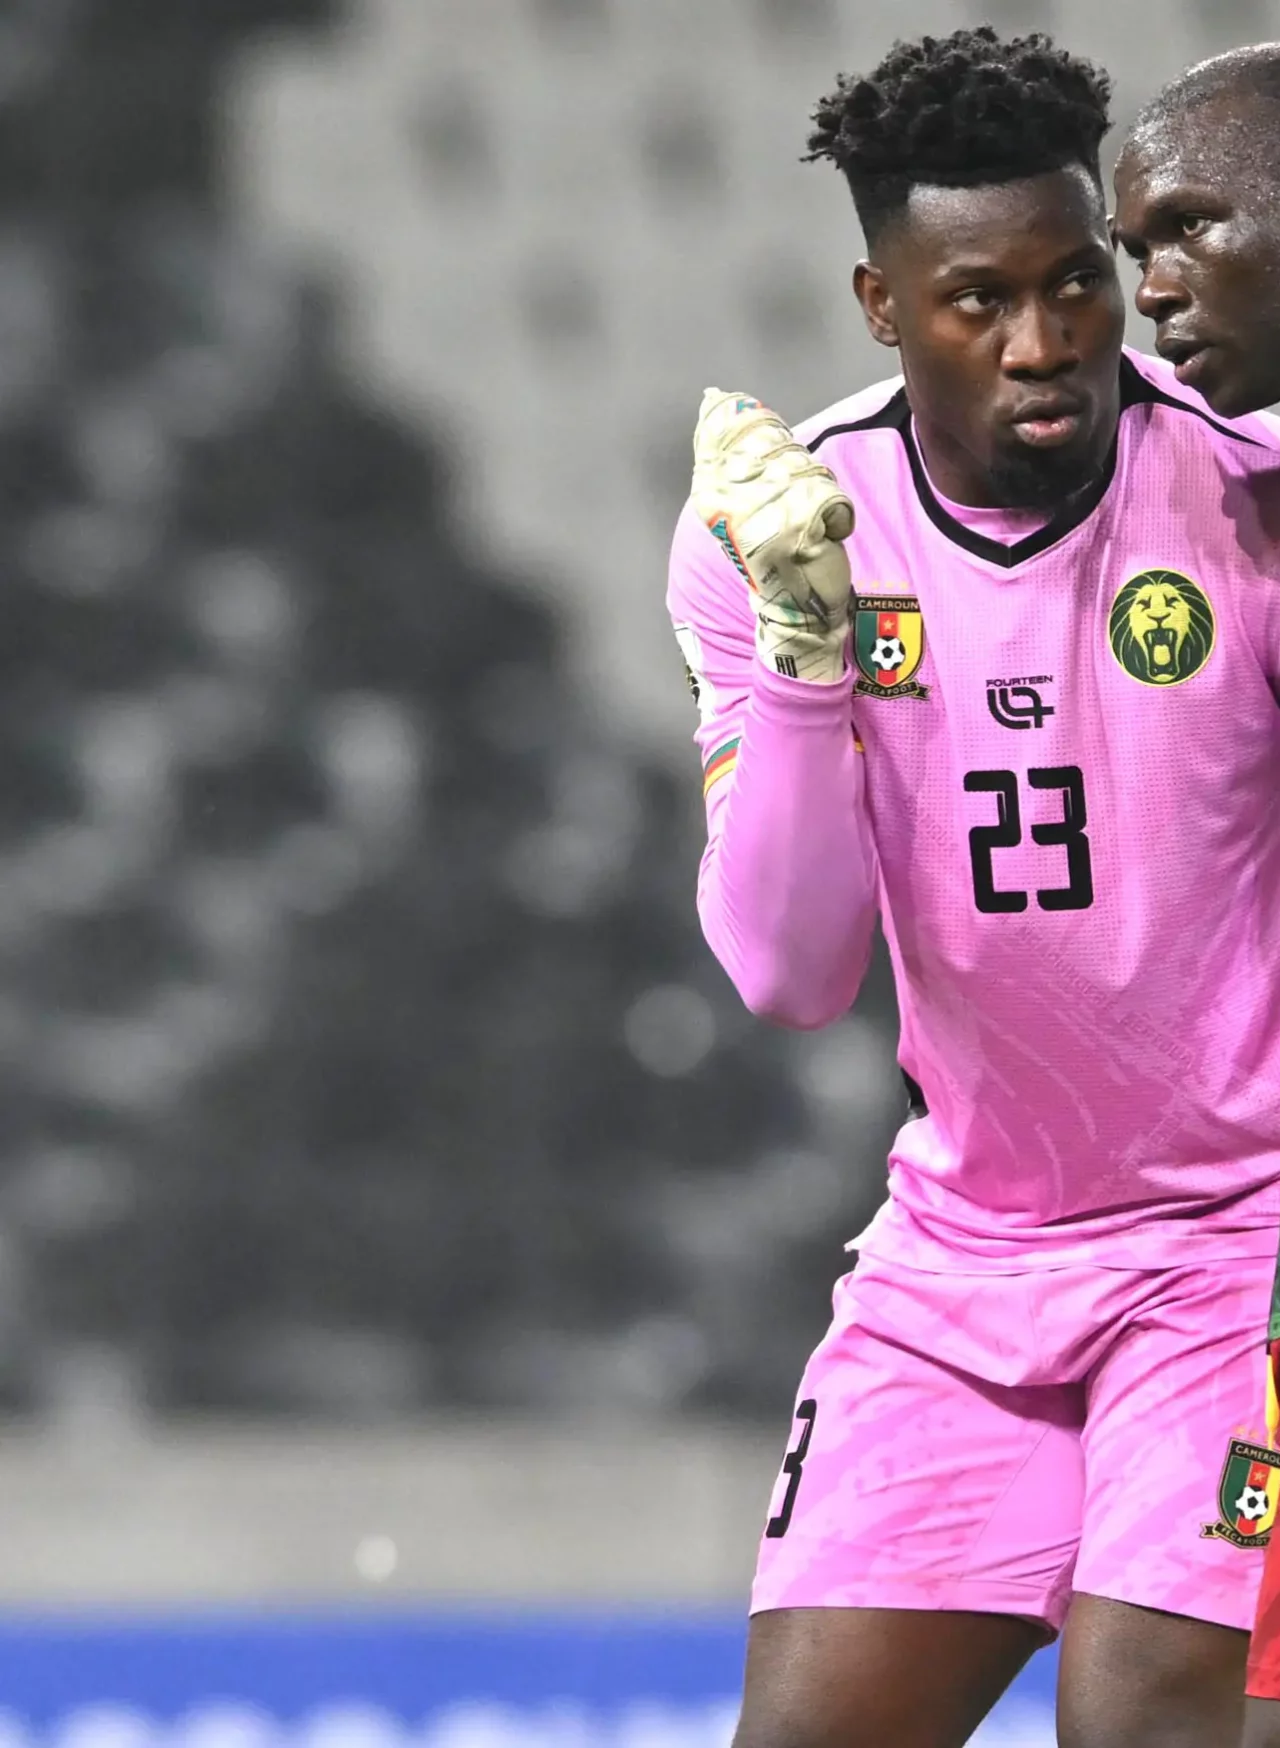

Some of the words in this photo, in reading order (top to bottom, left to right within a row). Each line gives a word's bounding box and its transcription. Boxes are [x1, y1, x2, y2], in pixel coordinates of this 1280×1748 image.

[858, 599, 920, 609] CAMEROUN
[985, 675, 1053, 688] FOURTEEN
[963, 765, 1094, 914] 23
[765, 1398, 817, 1538] 3
